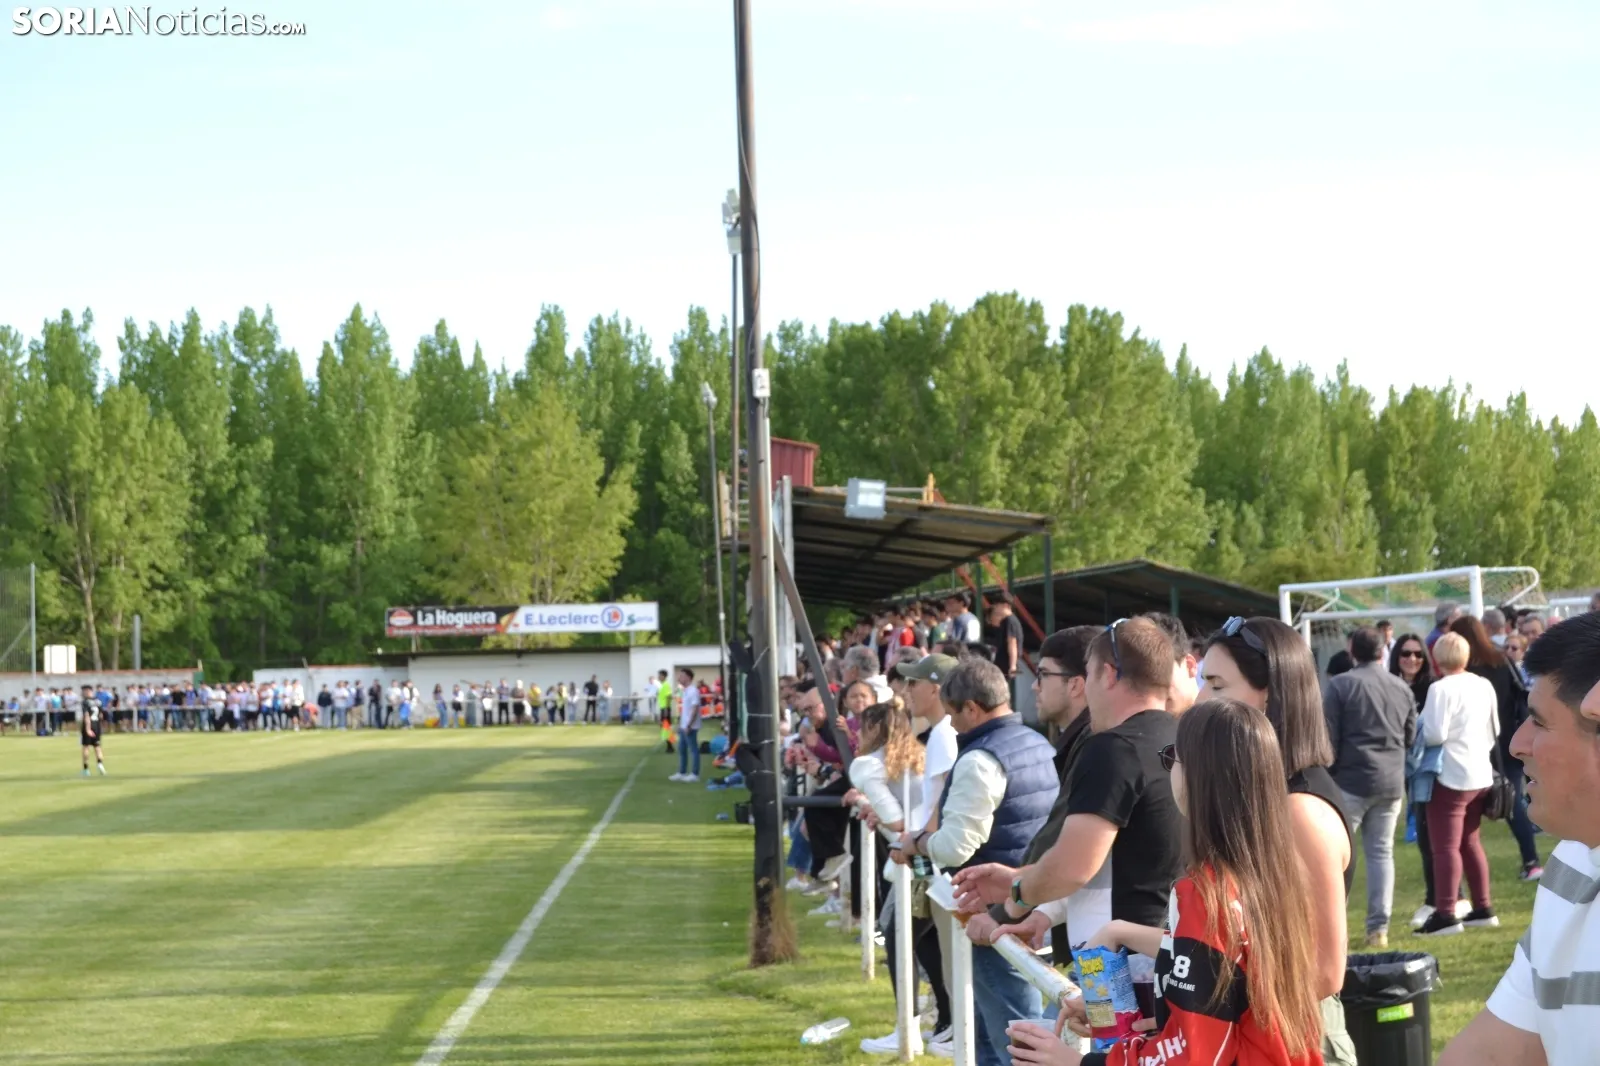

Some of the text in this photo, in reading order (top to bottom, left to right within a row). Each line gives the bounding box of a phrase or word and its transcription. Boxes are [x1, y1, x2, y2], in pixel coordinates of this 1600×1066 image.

[416, 609, 497, 629] La Hoguera
[1178, 981, 1196, 992] GAME
